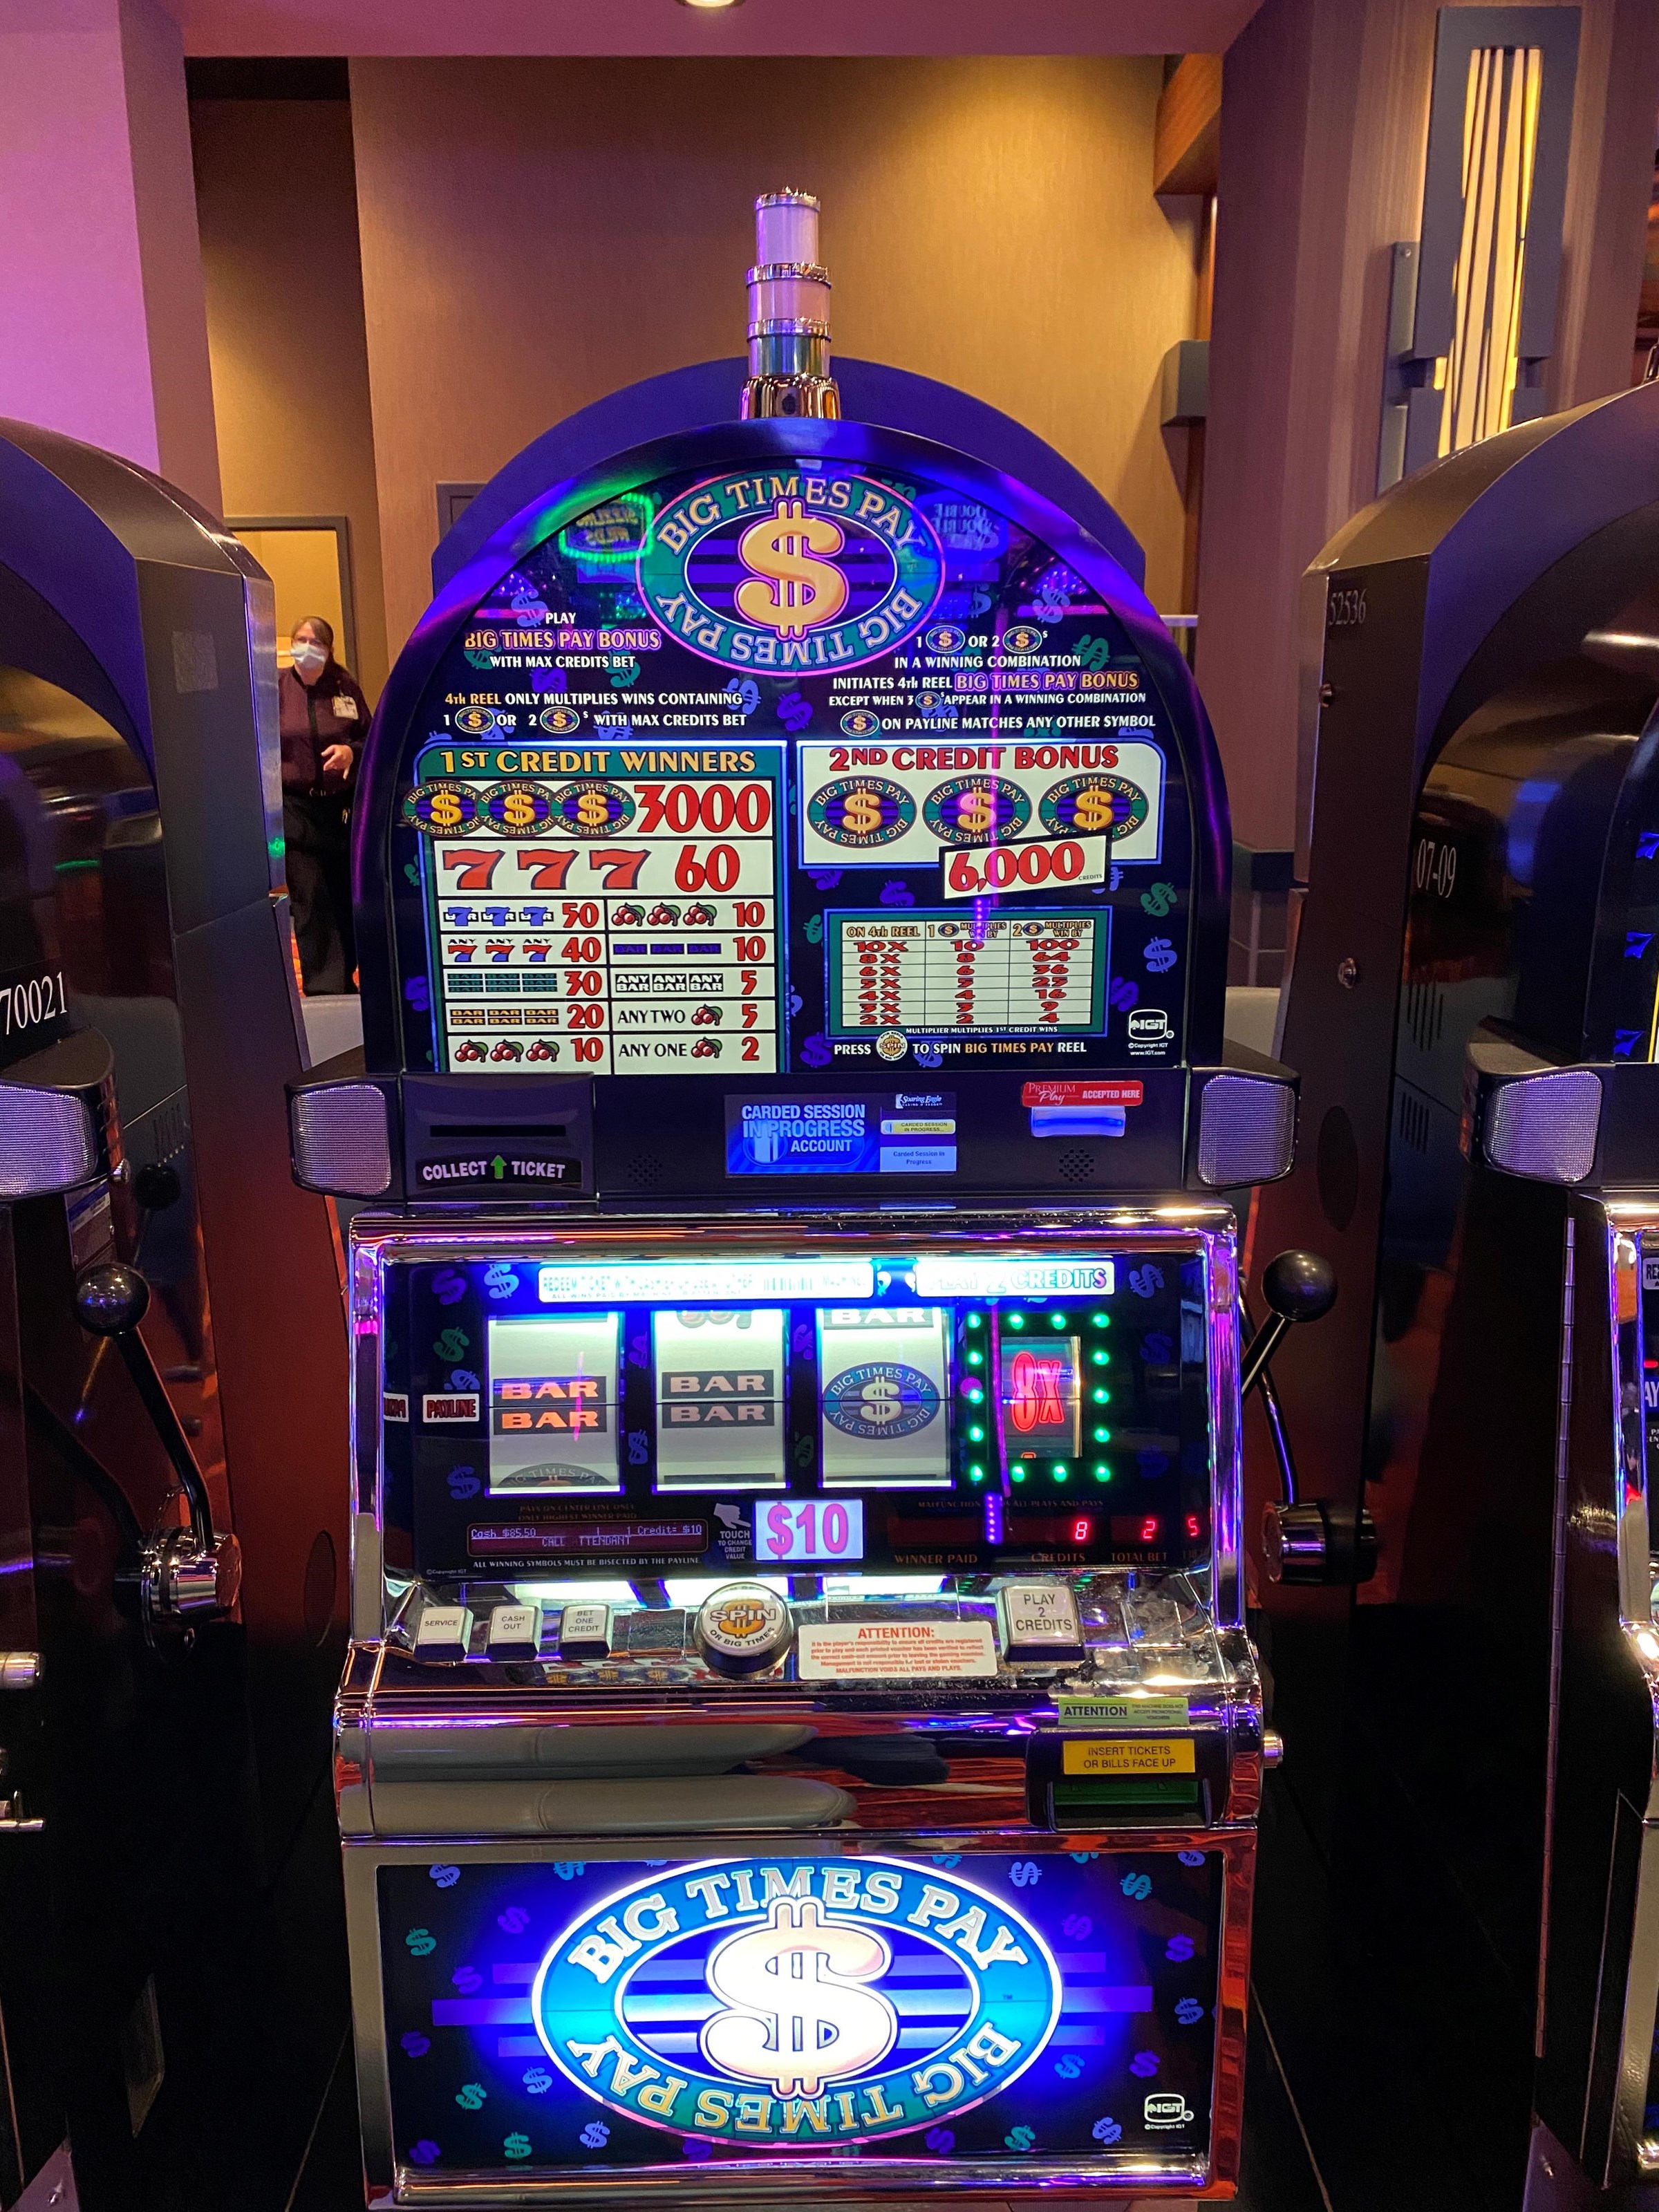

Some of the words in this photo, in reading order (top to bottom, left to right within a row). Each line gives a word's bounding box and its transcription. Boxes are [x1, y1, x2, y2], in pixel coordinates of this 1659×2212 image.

[657, 494, 720, 554] BIG
[726, 475, 852, 512] TIMES
[859, 489, 925, 547] PAY
[1329, 588, 1367, 626] 52536
[545, 612, 577, 625] PLAY
[465, 630, 498, 650] BIG
[501, 630, 555, 650] TIMES
[558, 630, 594, 650] PAY
[599, 629, 661, 650] BONUS
[968, 635, 988, 648] OR
[489, 655, 523, 668] WITH
[525, 655, 552, 668] MAX
[555, 655, 610, 668] CREDITS
[612, 655, 636, 668] BET
[894, 656, 909, 668] IN
[924, 655, 984, 668] WINNING
[987, 655, 1082, 668] COMBINATION
[833, 677, 894, 689] INITIATES
[921, 677, 953, 689] REEL
[955, 673, 987, 691] BIG
[991, 673, 1040, 690] TIMES
[1044, 672, 1078, 690] PAY
[1080, 671, 1140, 689] BONUS
[470, 693, 502, 705] REEL
[505, 693, 541, 705] ONLY
[544, 693, 618, 705] MULTIPLIES
[621, 693, 655, 705] WINS
[658, 693, 743, 705] CONTAINING
[829, 695, 870, 706] EXCEPT
[872, 695, 905, 706] WHEN
[944, 695, 987, 706] APPEAR
[990, 695, 1002, 705] IN
[1015, 694, 1065, 705] WINNING
[1067, 693, 1146, 704] COMBINATION
[496, 714, 517, 727] OR
[594, 714, 627, 727] WITH
[631, 714, 659, 727] MAX
[662, 714, 720, 727] CREDITS
[722, 714, 747, 726] BET
[881, 718, 902, 730] ON
[905, 718, 958, 730] PAYLINE
[962, 718, 1023, 729] MATCHES
[1026, 717, 1053, 729] ANY
[1056, 716, 1100, 729] OTHER
[1104, 715, 1156, 728] SYMBOL
[440, 750, 490, 773] 1ST
[496, 750, 610, 773] CREDIT
[620, 750, 756, 772] WINNERS
[829, 747, 888, 771] 2ND
[892, 747, 1006, 770] CREDIT
[1014, 746, 1119, 769] BONUS
[634, 783, 771, 834] 3000
[674, 844, 741, 892] 60
[948, 841, 1085, 892] 6,000
[1416, 838, 1457, 898] 07-09
[562, 902, 600, 928] 50
[733, 901, 766, 928] 10
[561, 937, 602, 963] 40
[1026, 939, 1080, 950] 100
[564, 971, 603, 997] 30
[0, 971, 68, 1035] 70021
[567, 1004, 605, 1030] 20
[617, 1010, 648, 1024] ANY
[650, 1009, 686, 1024] TWO
[570, 1037, 604, 1062] 10
[619, 1043, 651, 1058] ANY
[654, 1043, 688, 1058] ONE
[834, 1044, 872, 1055] PRESS
[912, 1043, 930, 1054] TO
[933, 1043, 962, 1054] SPIN
[965, 1043, 988, 1054] BIG
[991, 1042, 1027, 1053] TIMES
[1029, 1042, 1054, 1053] PAY
[1058, 1042, 1087, 1053] REEL
[903, 1095, 926, 1103] Soaring
[925, 1095, 942, 1103] Eagle
[1039, 1090, 1065, 1106] Play
[1082, 1090, 1120, 1099] ACCEPTED
[1121, 1089, 1141, 1098] HERE
[742, 1105, 801, 1121] CARDED
[803, 1104, 865, 1120] SESSION
[743, 1121, 764, 1138] IN
[767, 1120, 865, 1138] PROGRESS
[790, 1139, 852, 1153] ACCOUNT
[422, 1161, 488, 1181] COLLECT
[511, 1161, 566, 1179] TICKET
[1011, 1268, 1107, 1290] CREDITS
[670, 1375, 765, 1393] BAR
[830, 1374, 855, 1396] BIG
[856, 1367, 903, 1380] TIMES
[906, 1373, 932, 1394] PAY
[502, 1381, 599, 1400] BAR
[427, 1398, 476, 1418] PAYLINE
[471, 1528, 496, 1539] Cash
[682, 1524, 702, 1535] $10
[720, 1530, 751, 1539] TOUCH
[766, 1501, 849, 1559] $10
[894, 1554, 946, 1565] WINNER
[948, 1553, 978, 1564] PAID
[1031, 1552, 1085, 1563] CREDITS
[1112, 1552, 1145, 1562] TOTAL
[1147, 1552, 1168, 1562] BET
[1023, 1593, 1056, 1606] PLAY
[710, 1609, 776, 1622] SPIN
[1038, 1607, 1046, 1618] 2
[424, 1619, 458, 1627] SERVICE
[568, 1624, 599, 1633] CREDIT
[1015, 1619, 1073, 1632] CREDITS
[745, 1627, 775, 1646] TIMES
[858, 1627, 935, 1639] ATTENTION:
[1064, 1706, 1127, 1716] ATTENTION
[1089, 1747, 1125, 1756] INSERT
[1127, 1745, 1171, 1755] TICKETS
[1083, 1759, 1099, 1768] OR
[1102, 1759, 1130, 1768] BILLS
[1132, 1759, 1159, 1768] FACE
[1162, 1758, 1177, 1767] UP
[567, 1895, 679, 1983] BIG
[686, 1866, 908, 1919] TIMES
[906, 1883, 1030, 1971] PAY
